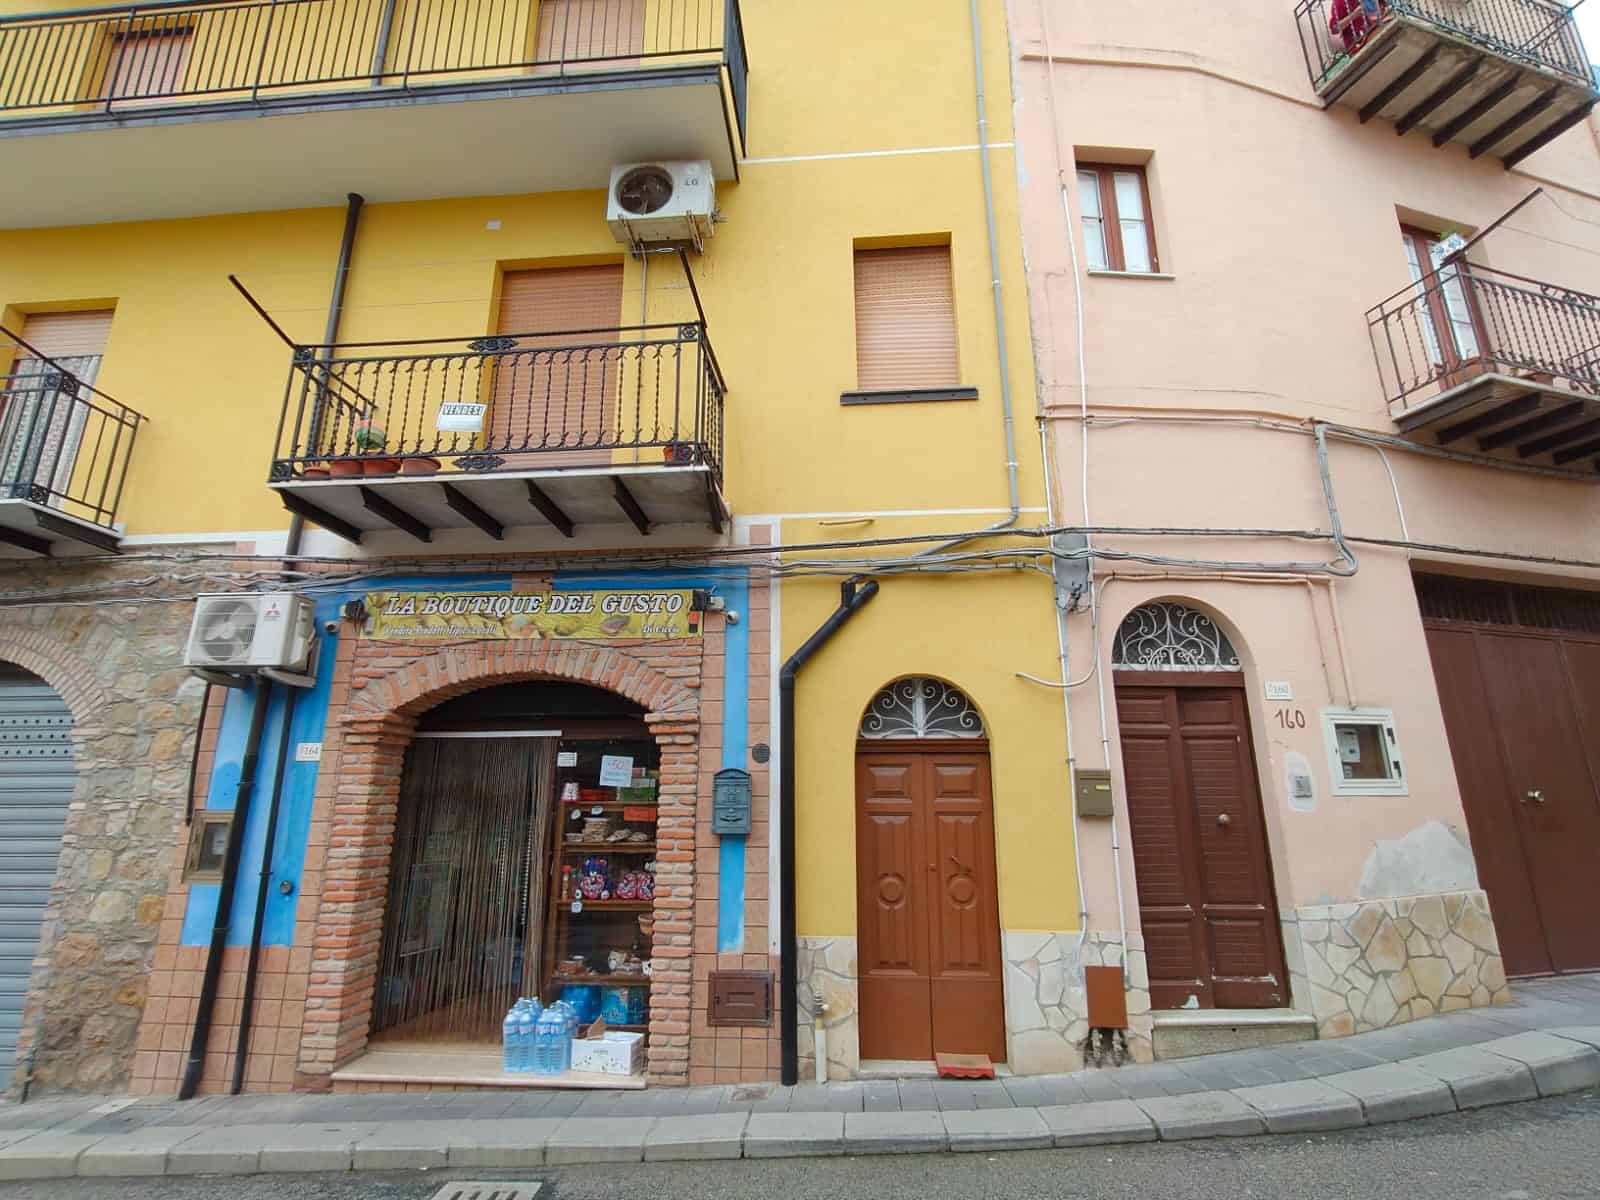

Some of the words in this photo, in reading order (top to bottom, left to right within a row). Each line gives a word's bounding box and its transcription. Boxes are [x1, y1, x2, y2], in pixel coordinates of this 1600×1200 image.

[442, 404, 485, 415] VENDESI
[384, 597, 416, 615] LA
[422, 595, 542, 617] BOUTIQUE
[547, 595, 594, 613] DEL
[601, 594, 682, 614] GUSTO
[1274, 709, 1306, 728] 160
